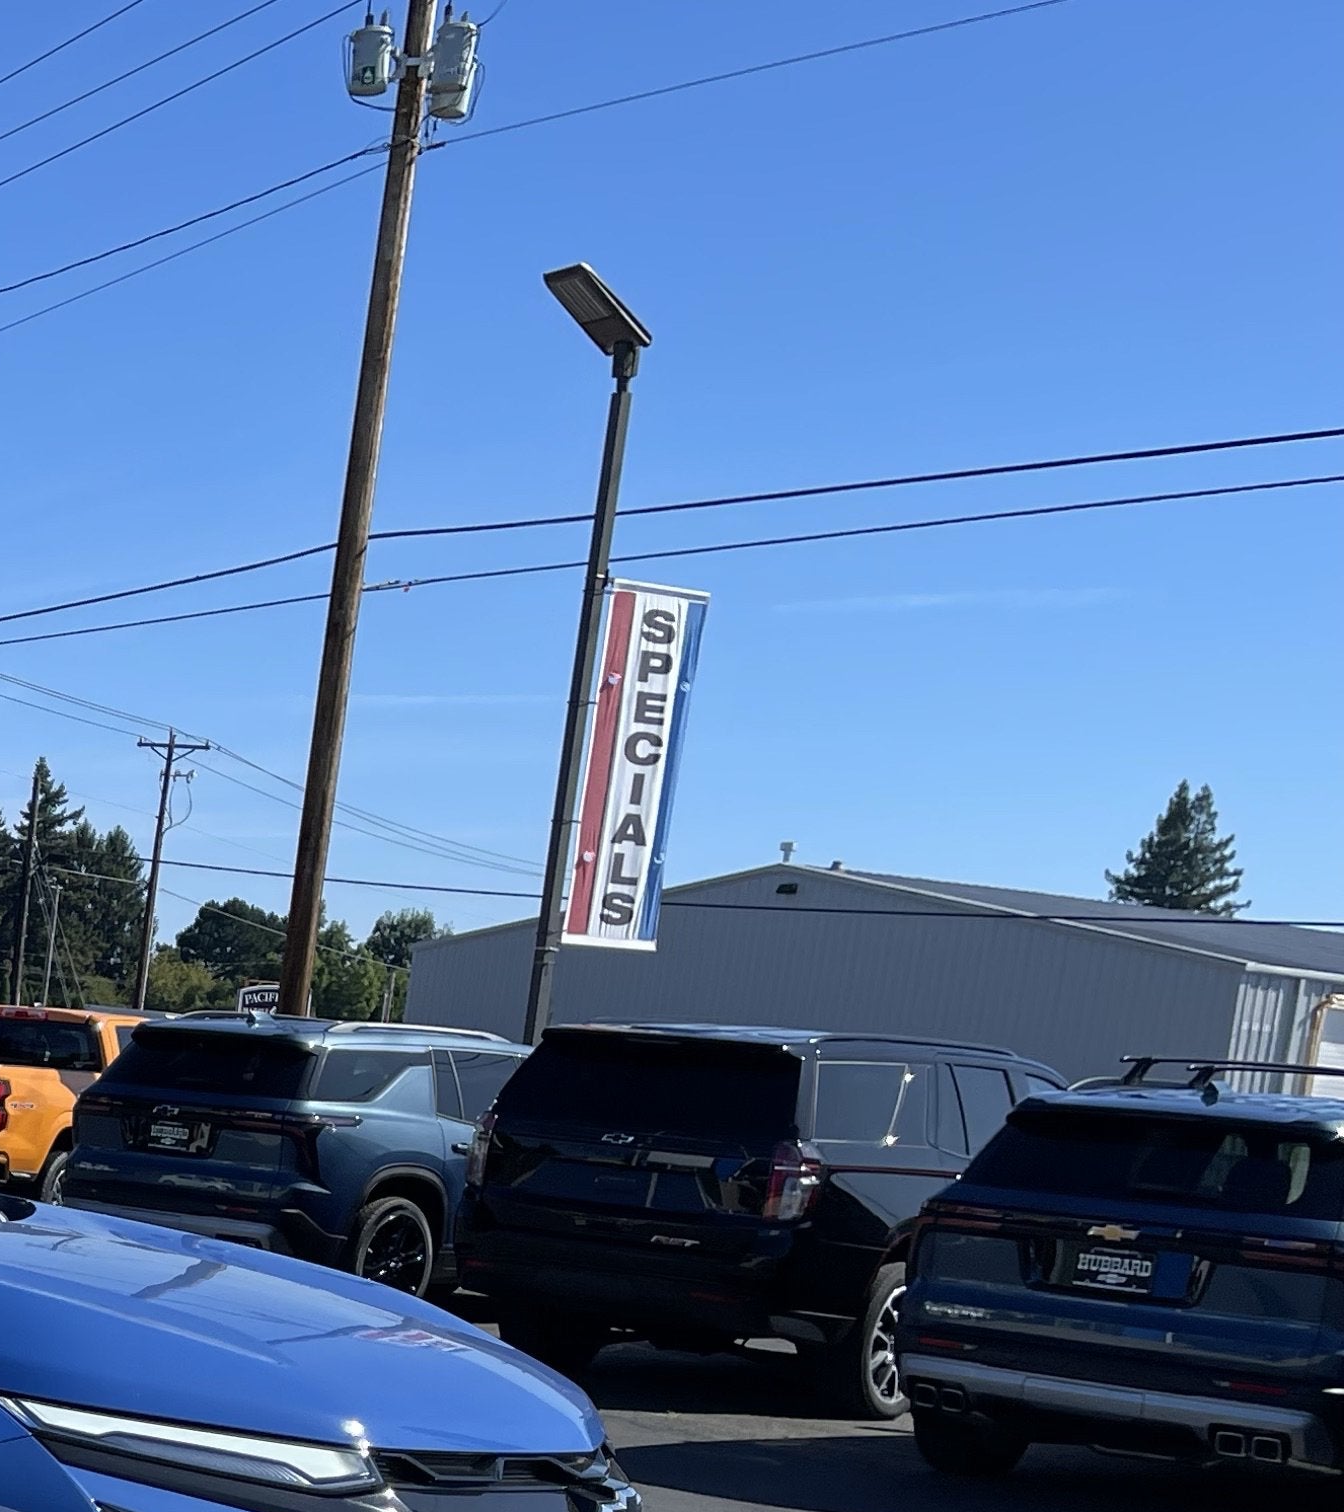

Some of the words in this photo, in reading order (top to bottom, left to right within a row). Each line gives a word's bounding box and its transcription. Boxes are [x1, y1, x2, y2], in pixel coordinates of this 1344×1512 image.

[599, 608, 676, 926] SPECIALS
[244, 992, 279, 1005] PACIFI
[1077, 1253, 1152, 1277] HUBBARD
